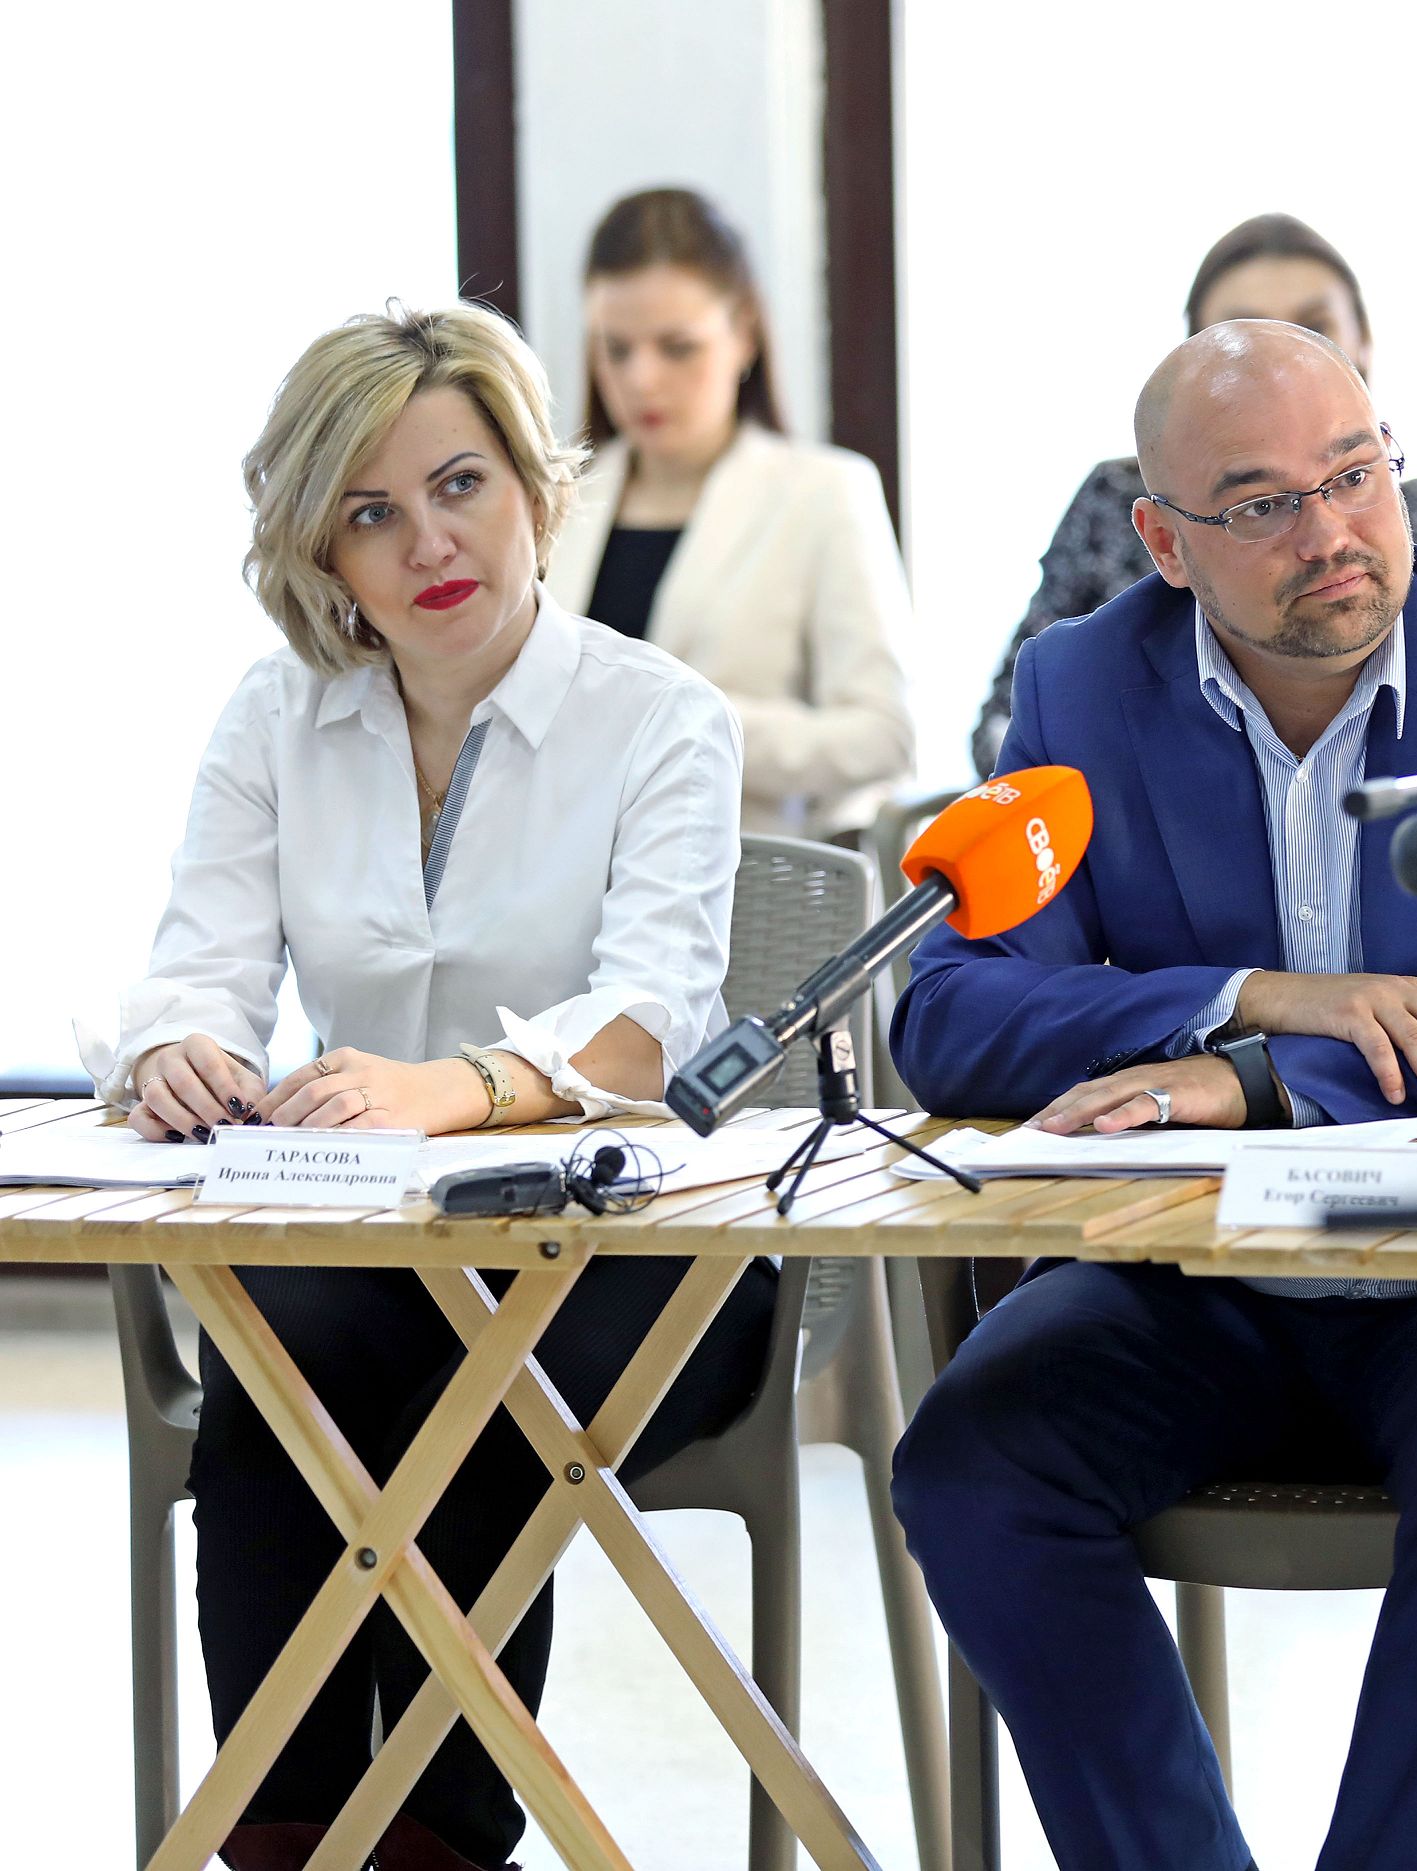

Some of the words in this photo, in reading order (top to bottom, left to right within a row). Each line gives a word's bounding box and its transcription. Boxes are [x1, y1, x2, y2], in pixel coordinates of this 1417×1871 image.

[265, 1149, 361, 1165] ТАРАСОВА
[218, 1167, 270, 1182] Ирина
[276, 1170, 397, 1186] Александровна
[1286, 1168, 1384, 1184] БАСОВИЧ
